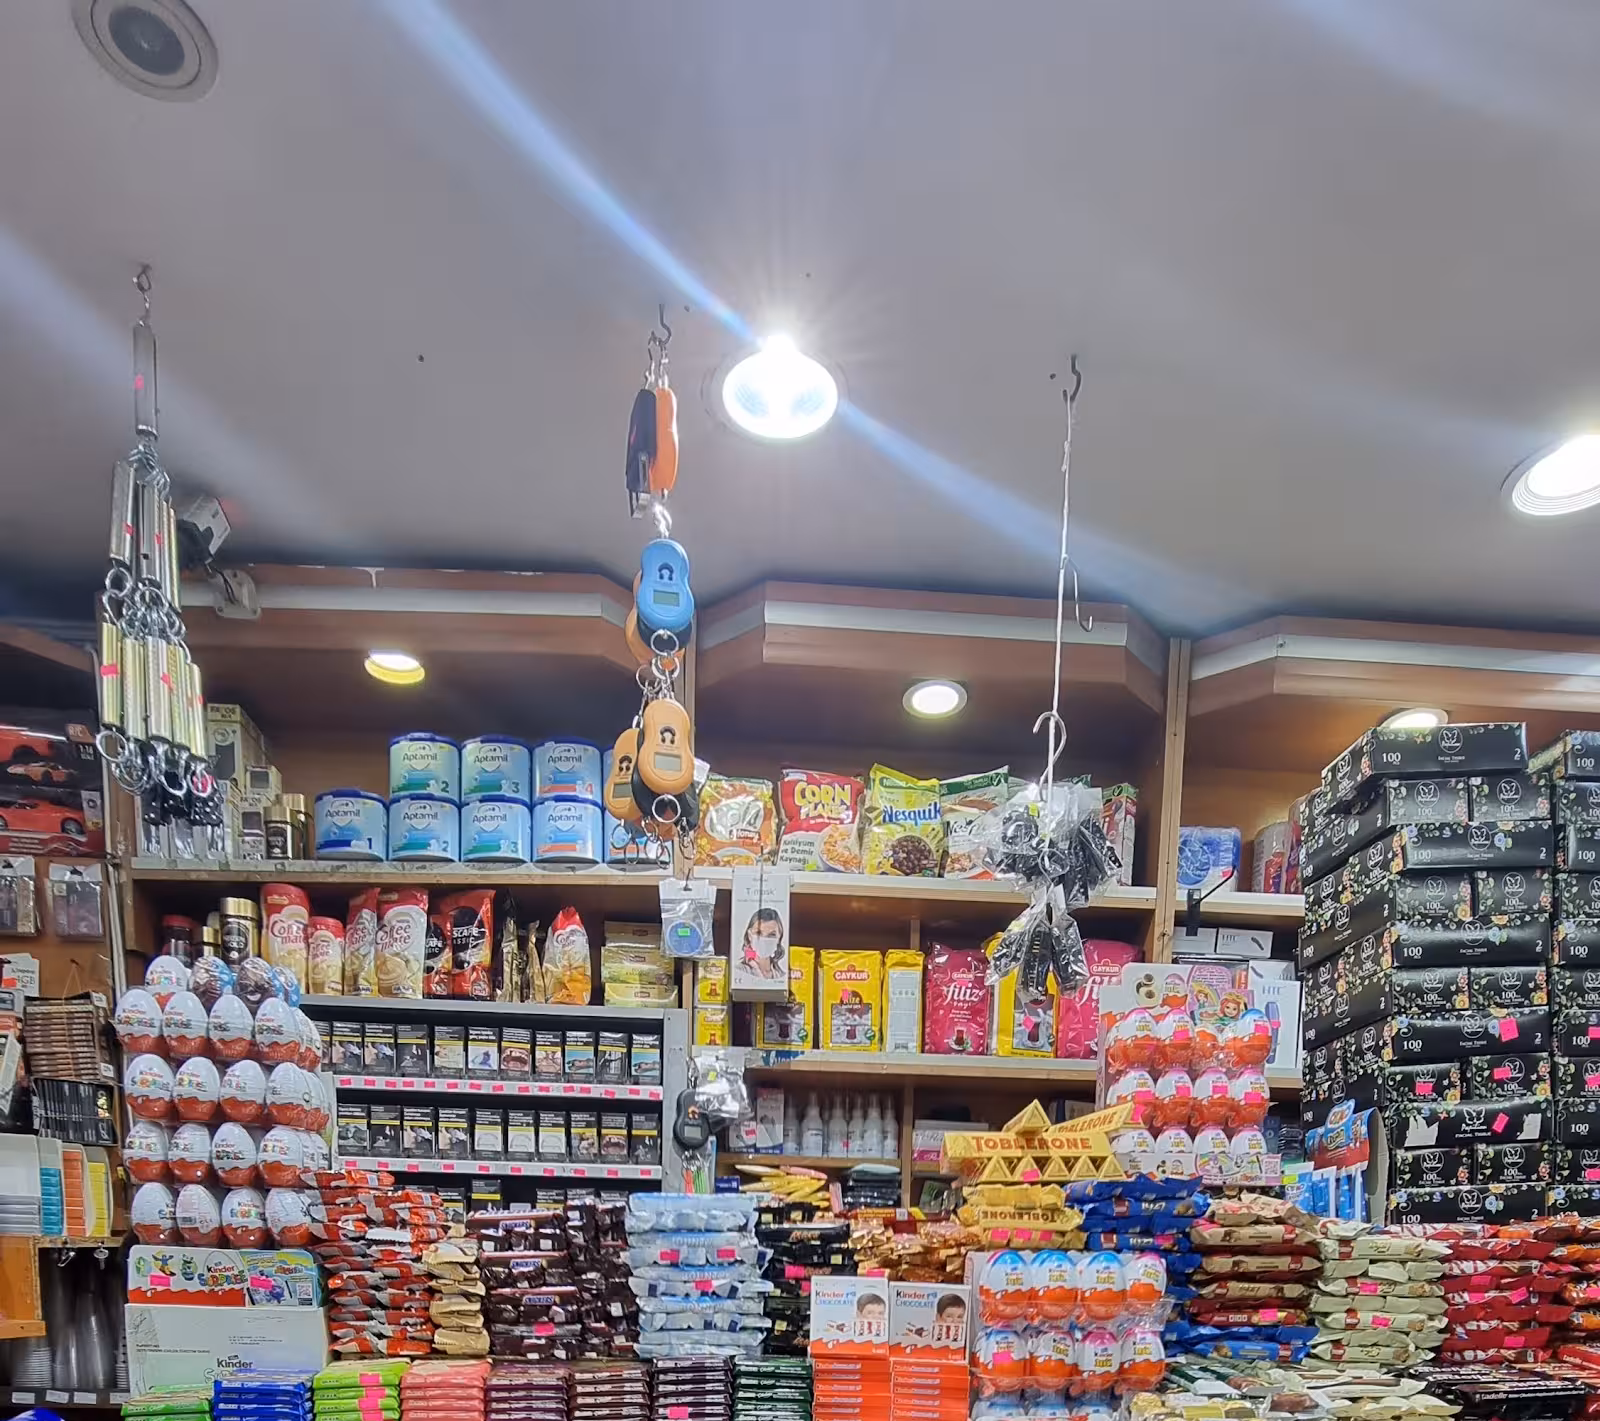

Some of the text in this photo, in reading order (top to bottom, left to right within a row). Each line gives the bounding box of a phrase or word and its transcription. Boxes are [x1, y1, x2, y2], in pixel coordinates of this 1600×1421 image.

[402, 753, 438, 763] Aptamil
[474, 755, 508, 764] Aptamil
[548, 755, 582, 764] Aptamil
[1382, 753, 1401, 762] 100
[1576, 758, 1594, 766] 100
[795, 783, 851, 806] CORN
[325, 809, 361, 819] Aptamil
[403, 812, 439, 822] Aptamil
[882, 802, 941, 823] Nesquik
[473, 813, 507, 823] Aptamil
[548, 813, 582, 823] Aptamil
[1414, 850, 1432, 859] 100
[1578, 851, 1595, 860] 100
[1403, 947, 1422, 956] 100
[1570, 946, 1588, 955] 100
[1403, 1040, 1422, 1049] 100
[1571, 1124, 1589, 1132] 100
[972, 1135, 1092, 1152] TOBLERONE
